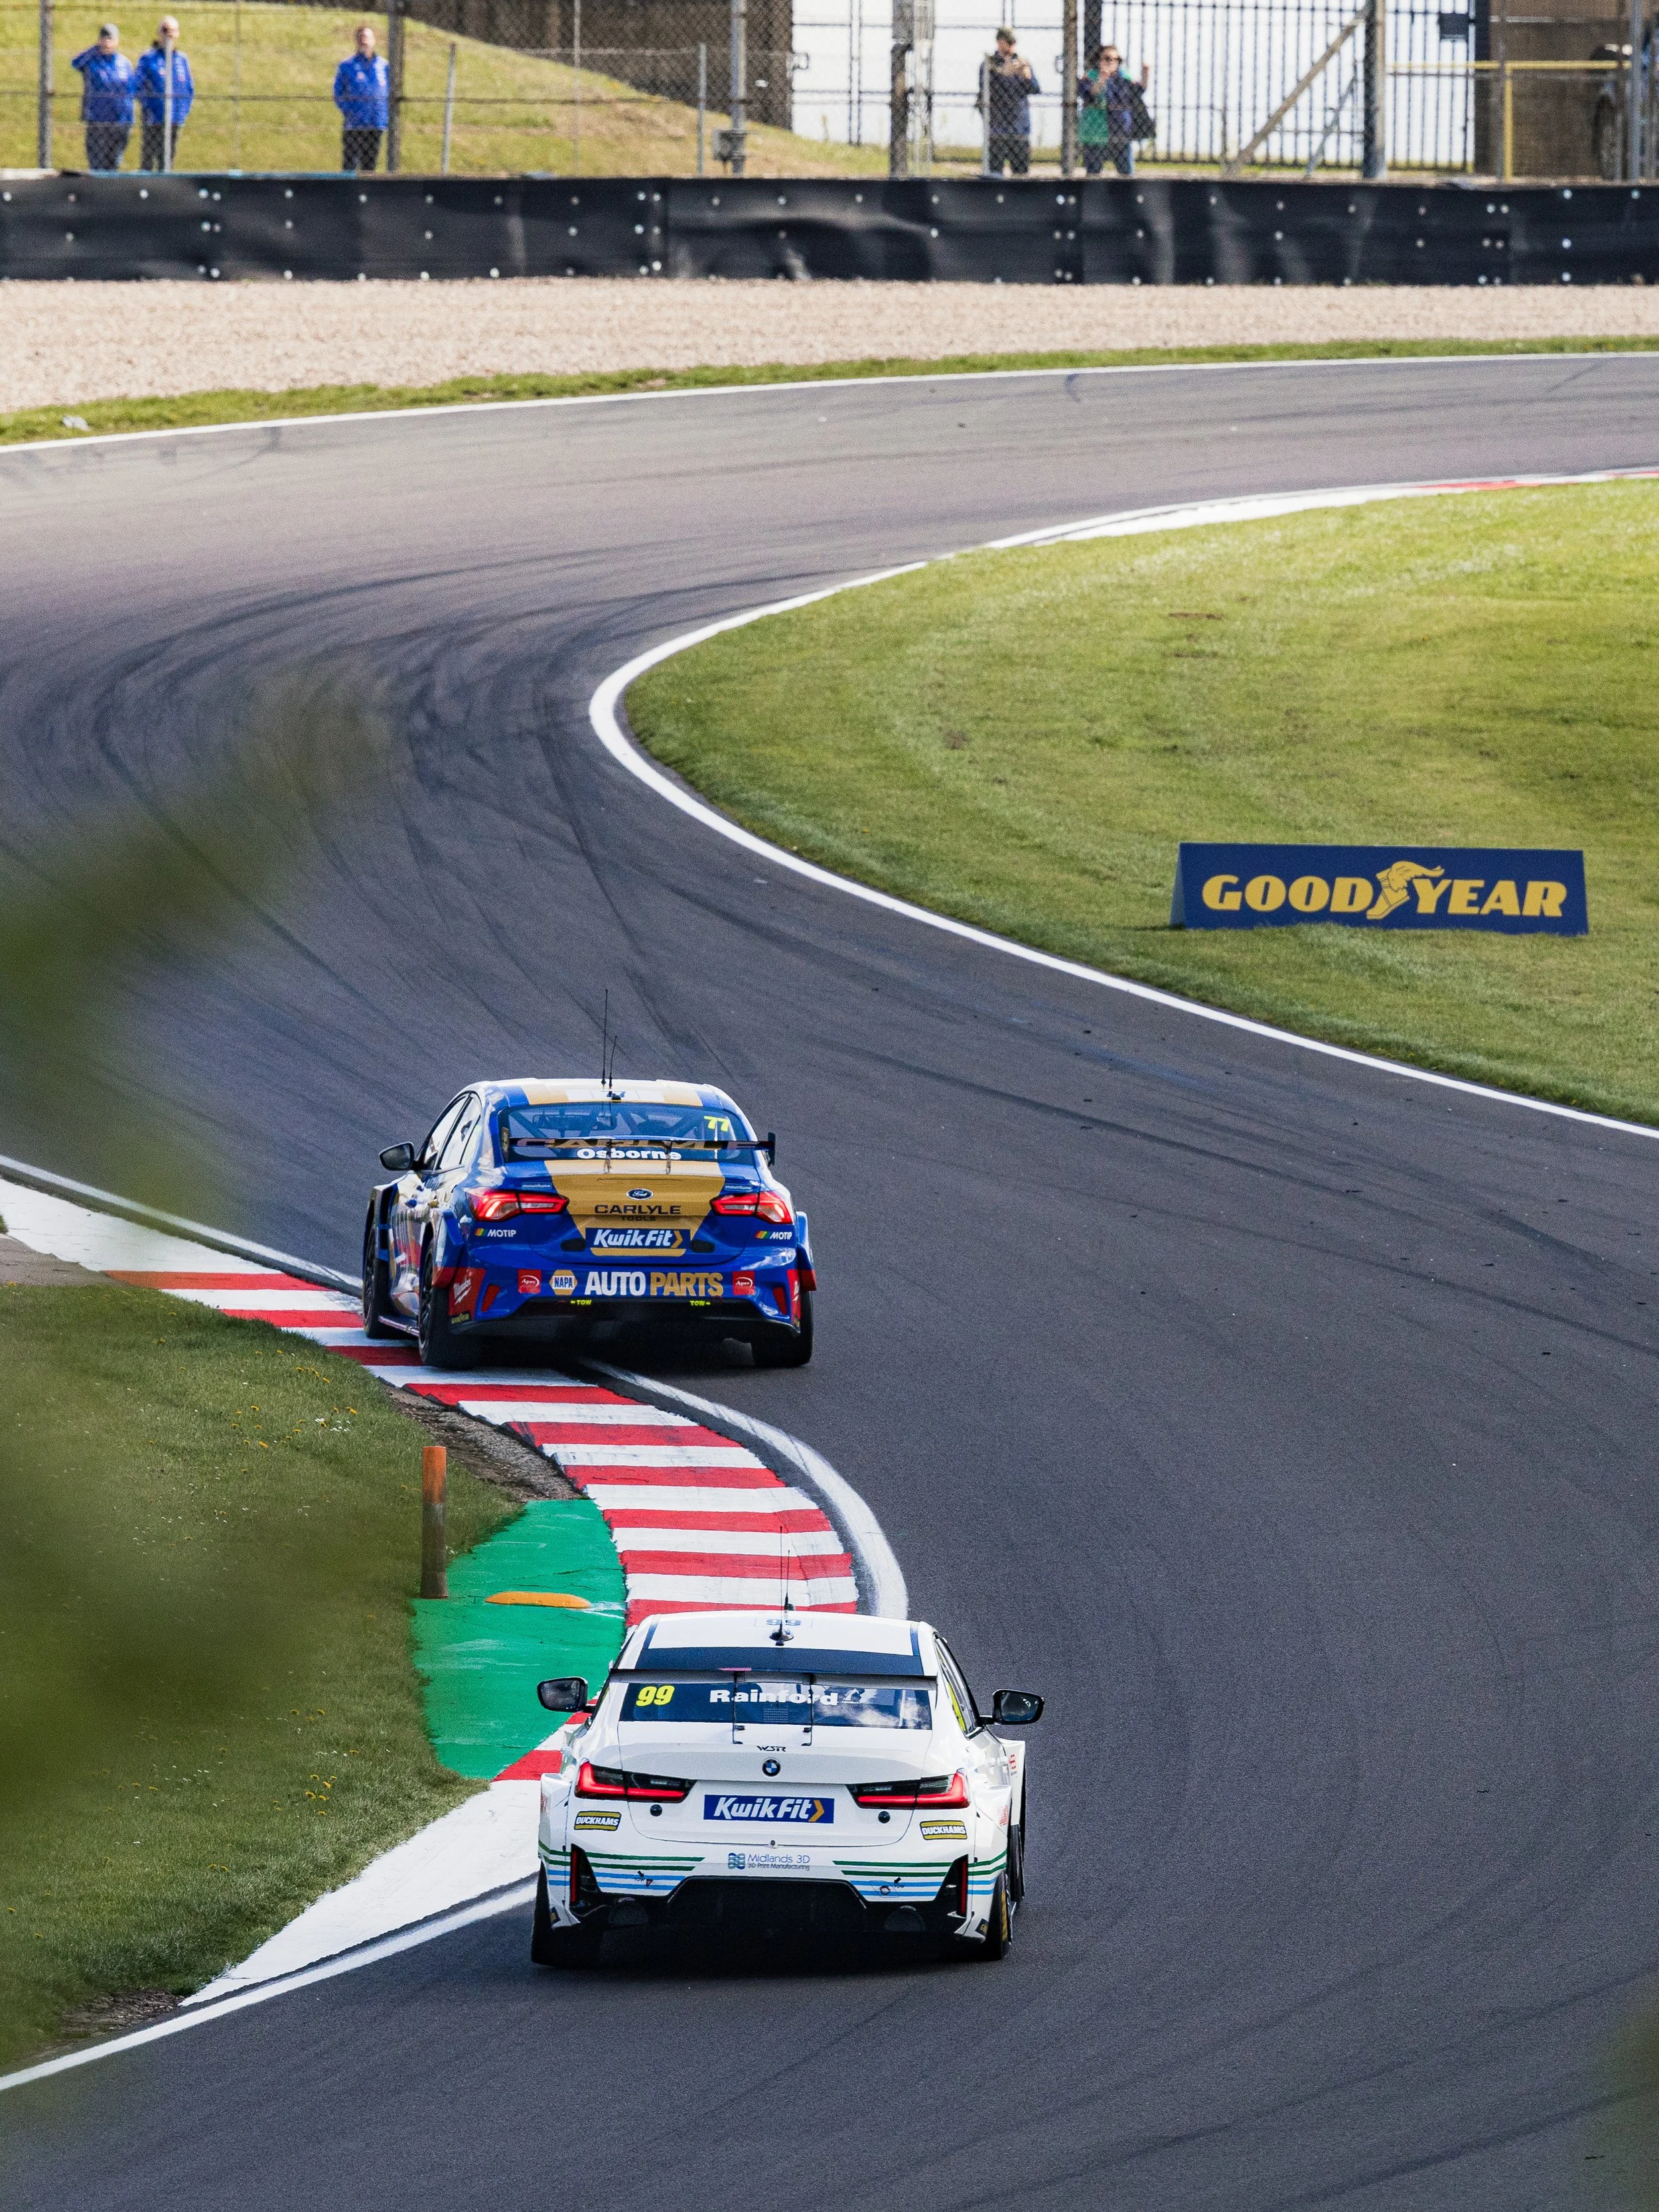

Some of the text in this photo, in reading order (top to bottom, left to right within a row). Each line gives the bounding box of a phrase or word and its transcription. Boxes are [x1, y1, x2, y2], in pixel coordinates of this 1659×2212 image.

[703, 1116, 729, 1132] 77
[577, 1148, 682, 1160] Osborne
[594, 1205, 682, 1215] CARLYLE
[487, 1229, 517, 1238] MOTIP
[770, 1231, 792, 1240] MOTIP
[554, 1272, 724, 1297] NAPA AUTO PARTS
[636, 1685, 675, 1707] 99
[709, 1689, 838, 1706] Rainford
[576, 1816, 620, 1826] DUCKHAMS
[922, 1826, 966, 1835] DUCKHAMS
[747, 1854, 810, 1864] Midlands 3D
